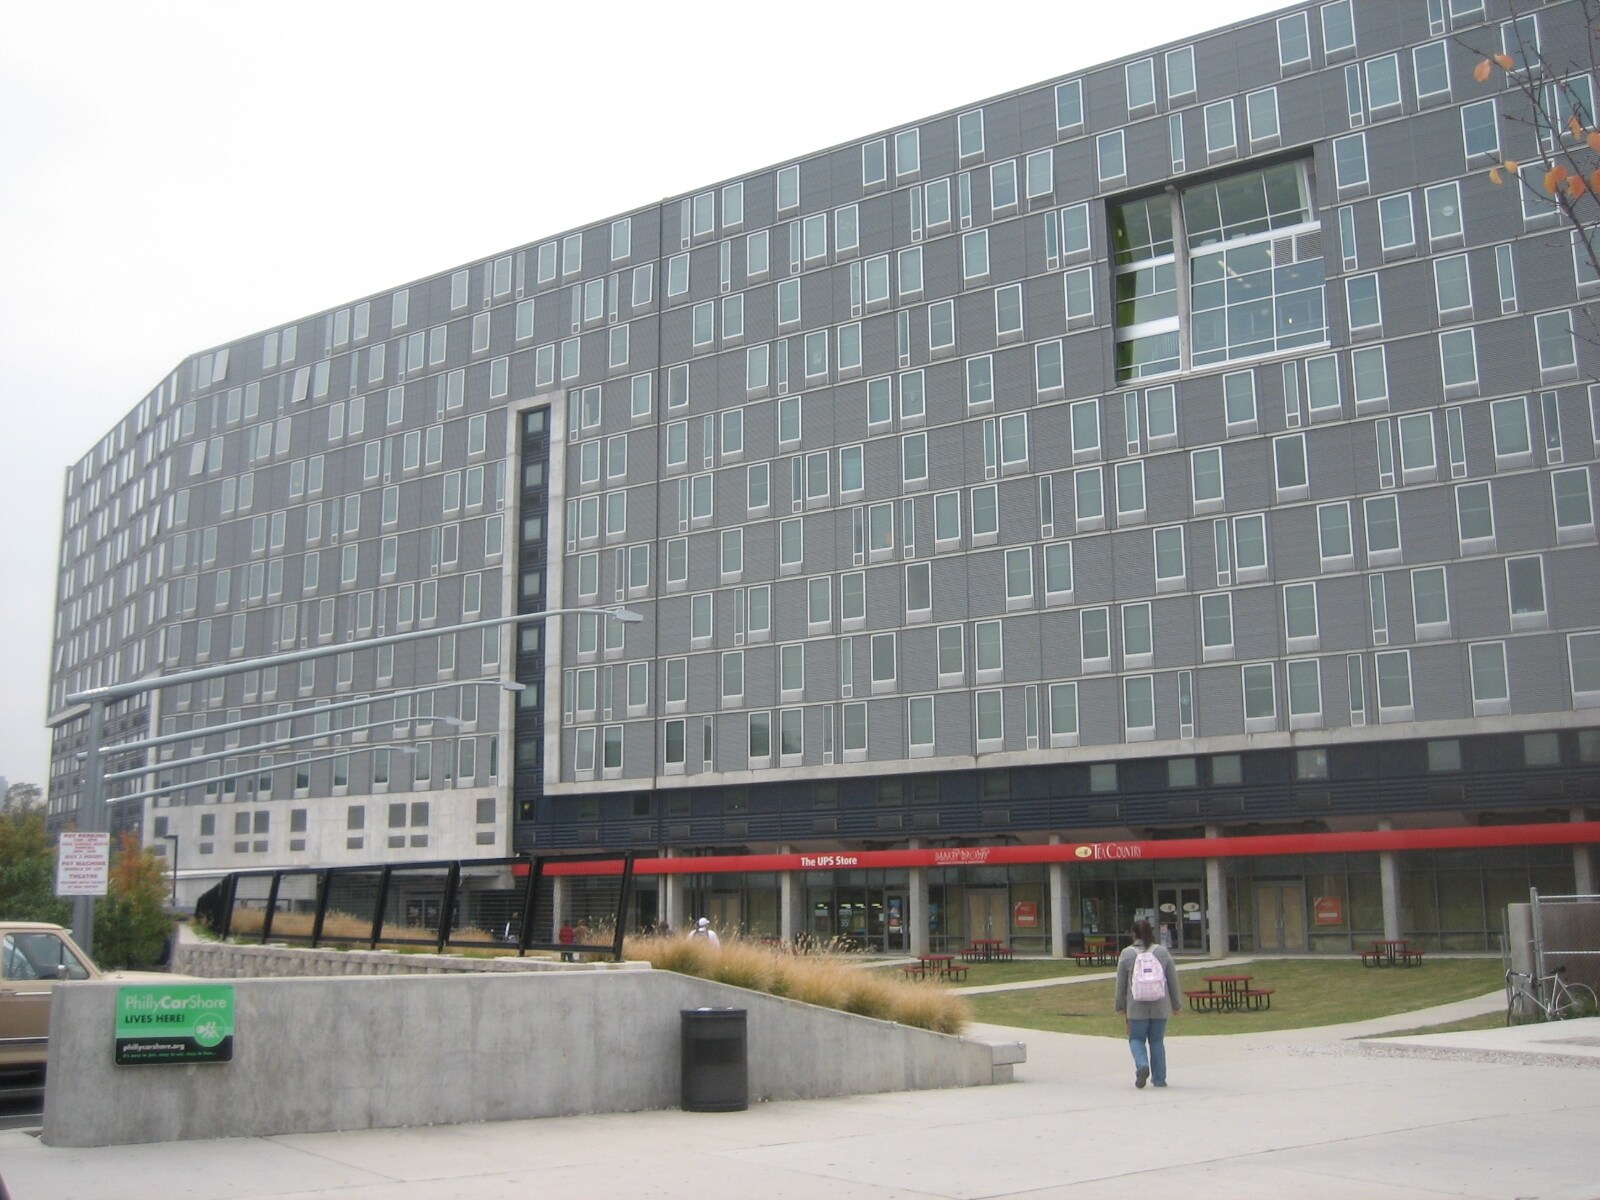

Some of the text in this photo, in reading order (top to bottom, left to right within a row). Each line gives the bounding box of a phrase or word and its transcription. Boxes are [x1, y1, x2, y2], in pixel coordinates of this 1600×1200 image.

[801, 855, 858, 867] The UPS Store
[126, 994, 227, 1012] PhillyCarShare
[125, 1014, 185, 1023] LIVES HERE!
[123, 1043, 185, 1052] phillycarshare.org
